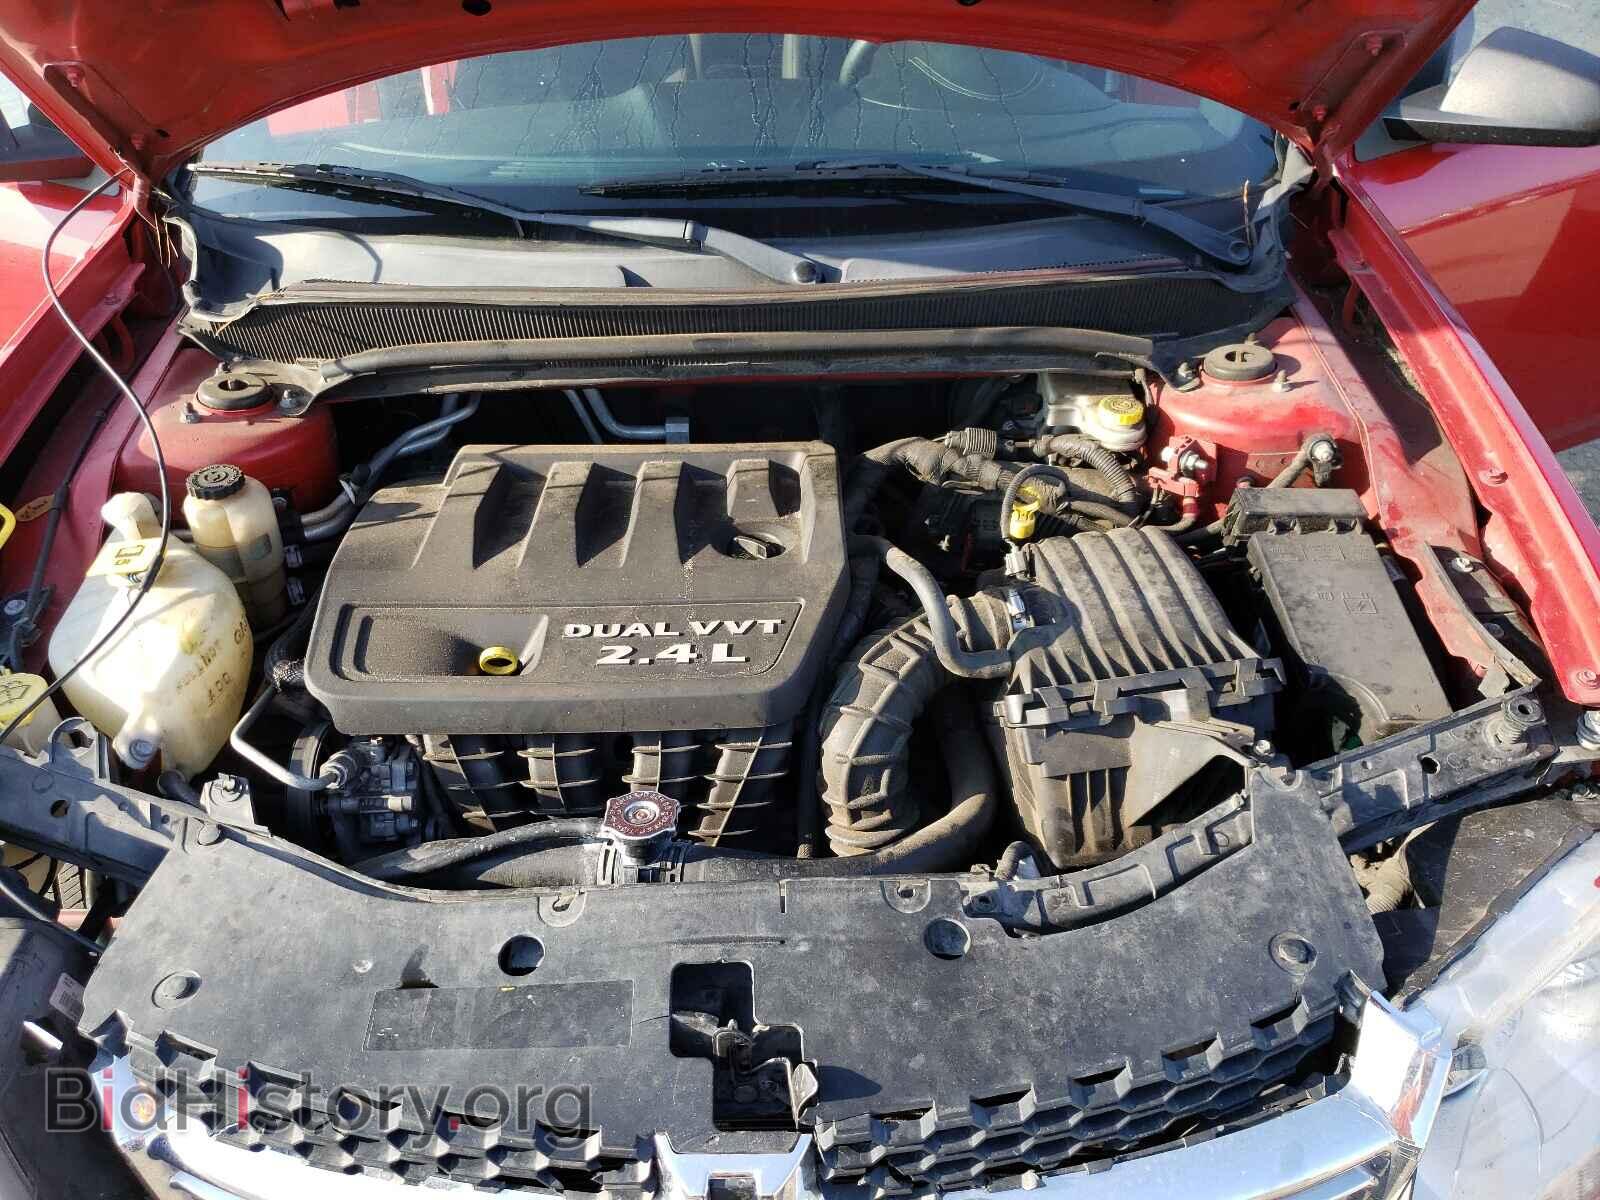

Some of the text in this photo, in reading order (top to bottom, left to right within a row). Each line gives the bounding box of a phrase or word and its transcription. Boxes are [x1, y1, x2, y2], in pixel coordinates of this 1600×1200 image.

[562, 619, 785, 639] DUAL VVT
[595, 642, 750, 665] 2.4L
